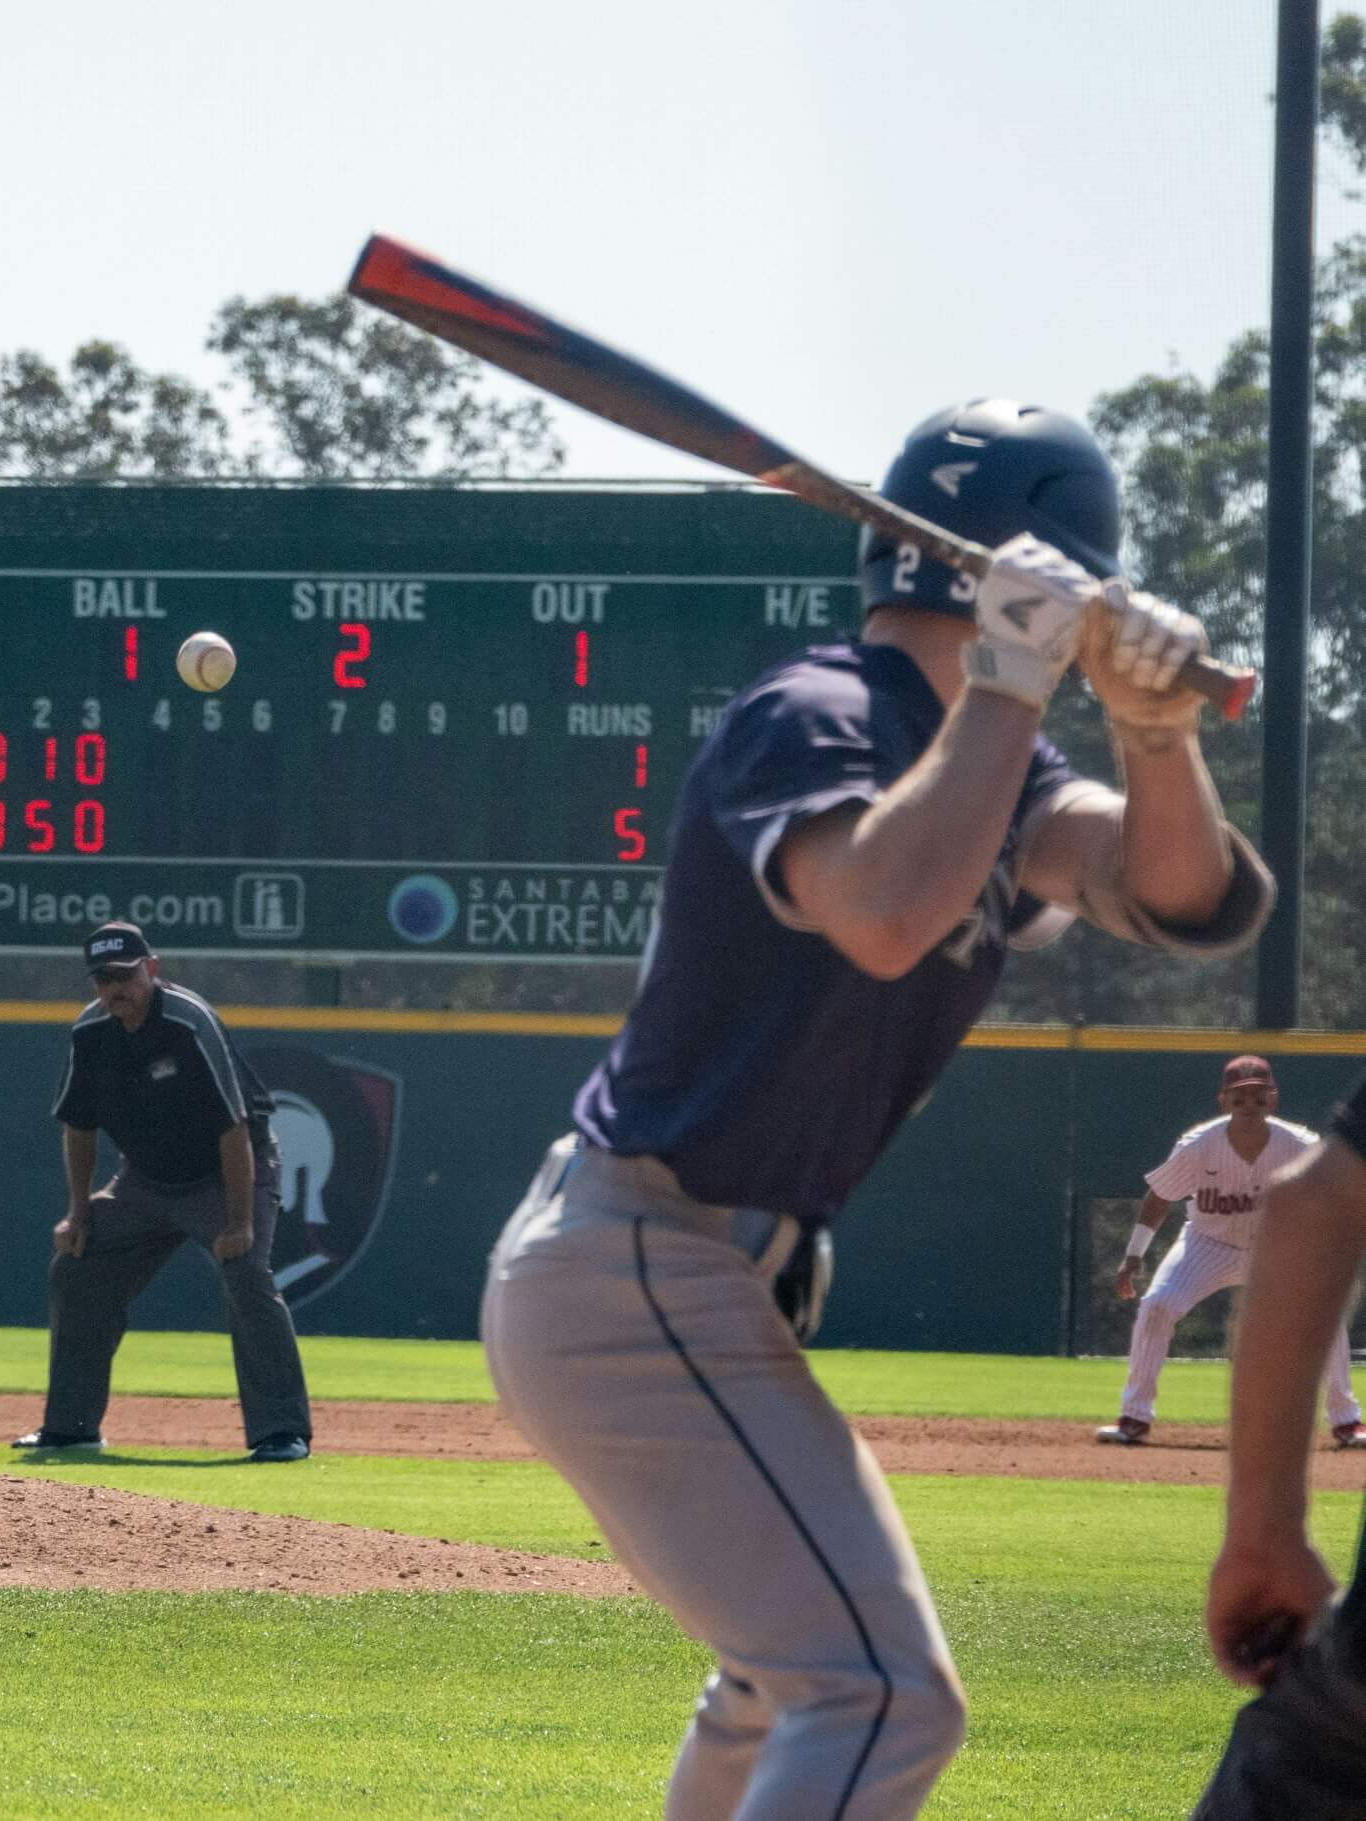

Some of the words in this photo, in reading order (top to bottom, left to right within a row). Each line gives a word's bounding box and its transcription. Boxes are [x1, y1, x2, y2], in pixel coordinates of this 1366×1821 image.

[893, 543, 920, 593] 2
[73, 579, 166, 618] BALL
[292, 581, 426, 620] STRIKE
[532, 583, 611, 623] OUT
[765, 586, 830, 628] H/E
[124, 626, 138, 680] 1
[334, 623, 371, 688] 2
[575, 631, 588, 686] 1
[33, 699, 52, 729] 2
[81, 700, 101, 729] 3
[152, 700, 171, 731] 4
[202, 701, 222, 731] 5
[252, 701, 273, 732] 6
[329, 702, 347, 733] 7
[378, 703, 396, 734] 8
[429, 703, 446, 735] 9
[494, 704, 528, 736] 10
[568, 704, 651, 737] RUNS
[45, 736, 57, 781] 1
[75, 732, 106, 786] 0
[635, 744, 648, 788] 1
[25, 800, 55, 852] 5
[74, 799, 105, 853] 0
[614, 807, 646, 861] 5
[467, 903, 660, 945] EXTREM
